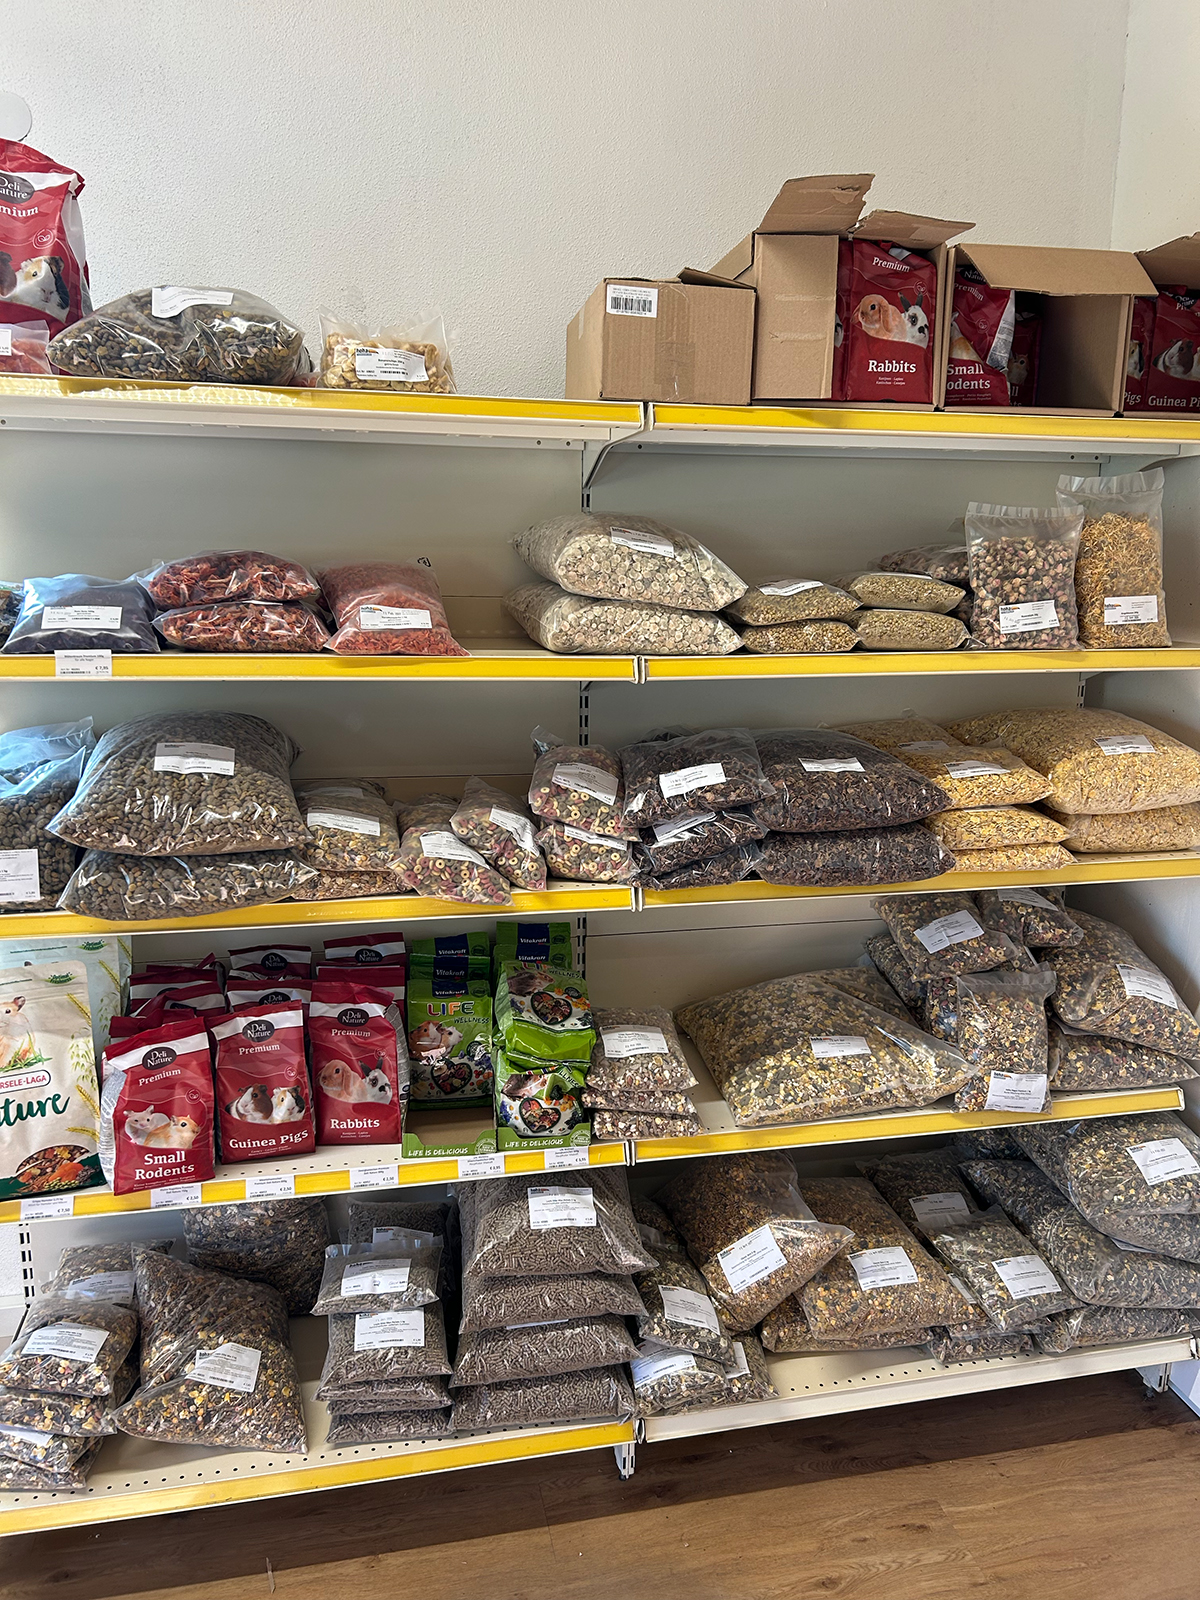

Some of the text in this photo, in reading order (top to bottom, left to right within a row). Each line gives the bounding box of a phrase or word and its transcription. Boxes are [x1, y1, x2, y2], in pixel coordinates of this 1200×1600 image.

[0, 187, 28, 199] ature
[0, 205, 39, 217] mium
[872, 256, 911, 273] Premium
[867, 360, 917, 373] Rabbits
[946, 379, 991, 390] odents
[1148, 395, 1200, 409] Guinea Pi
[358, 954, 380, 962] Nature
[363, 948, 376, 957] Deli
[269, 992, 283, 1001] Deli
[427, 1000, 475, 1017] LIFE
[341, 1015, 366, 1024] Nature
[347, 1010, 361, 1019] Deli
[453, 1016, 490, 1025] WELLNESS
[247, 1029, 271, 1038] Nature
[251, 1023, 267, 1033] Deli
[331, 1028, 371, 1037] Premium
[238, 1043, 280, 1056] Premium
[151, 1050, 167, 1061] Deli
[147, 1056, 173, 1068] Nature
[0, 1075, 47, 1089] RSELE-LAGA
[138, 1068, 182, 1086] Premium
[0, 1093, 71, 1127] ture
[330, 1118, 380, 1129] Rabbits
[229, 1129, 309, 1149] Guinea Pigs
[505, 1140, 520, 1148] LIFE
[528, 1138, 564, 1147] DELICIOUS
[408, 1148, 424, 1156] LIFE
[432, 1147, 468, 1155] DELICIOUS
[144, 1150, 186, 1165] Small
[134, 1163, 195, 1181] Rodents
